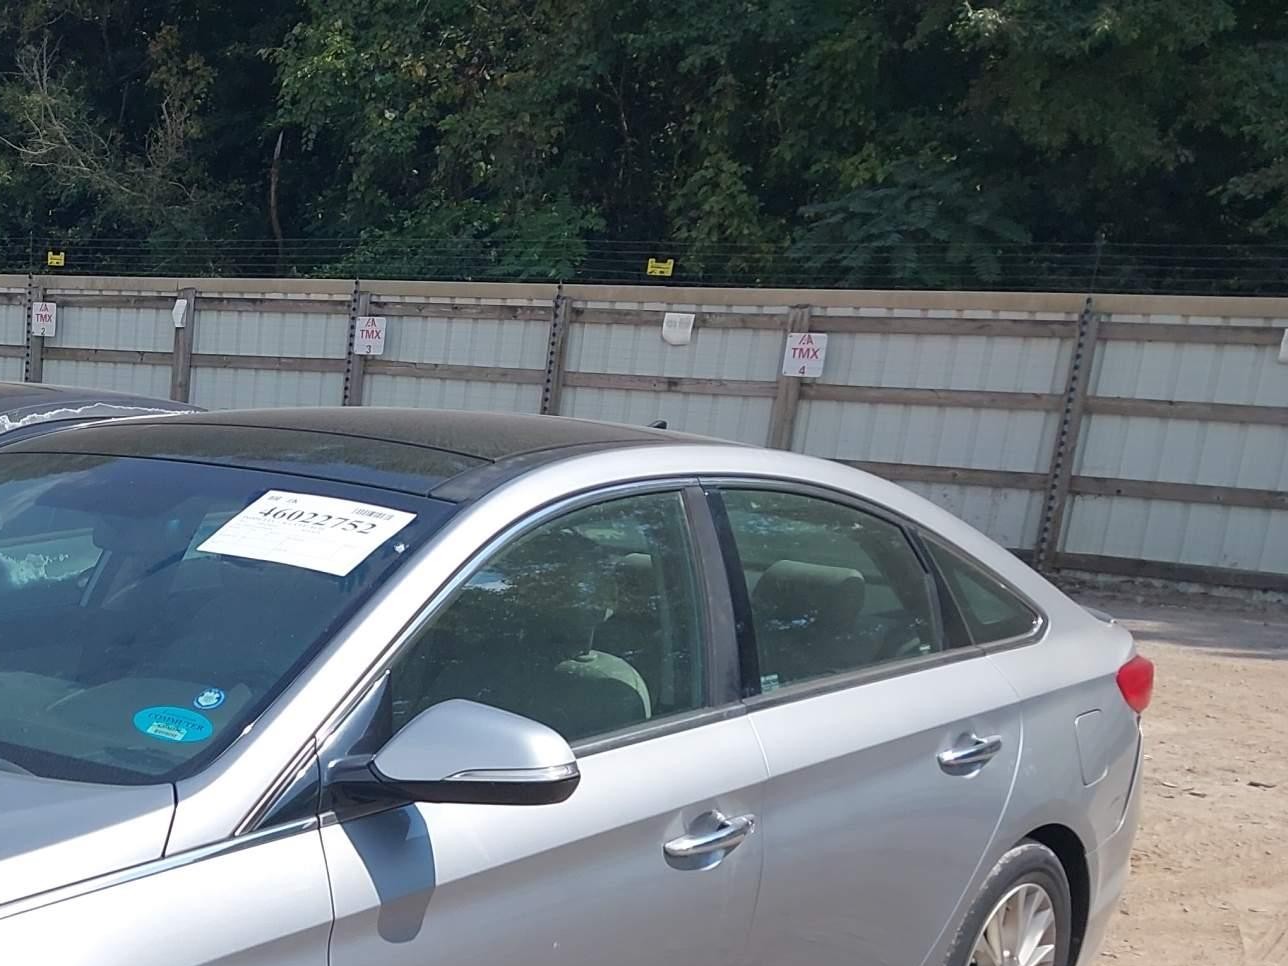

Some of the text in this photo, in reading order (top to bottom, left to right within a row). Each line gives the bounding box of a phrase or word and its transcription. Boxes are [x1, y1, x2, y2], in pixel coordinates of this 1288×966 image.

[35, 313, 52, 322] TMX
[41, 327, 46, 335] 2
[359, 329, 381, 339] TMX
[365, 345, 372, 354] 3
[792, 347, 820, 359] TMX
[798, 365, 806, 374] 4
[258, 505, 378, 535] 46022752
